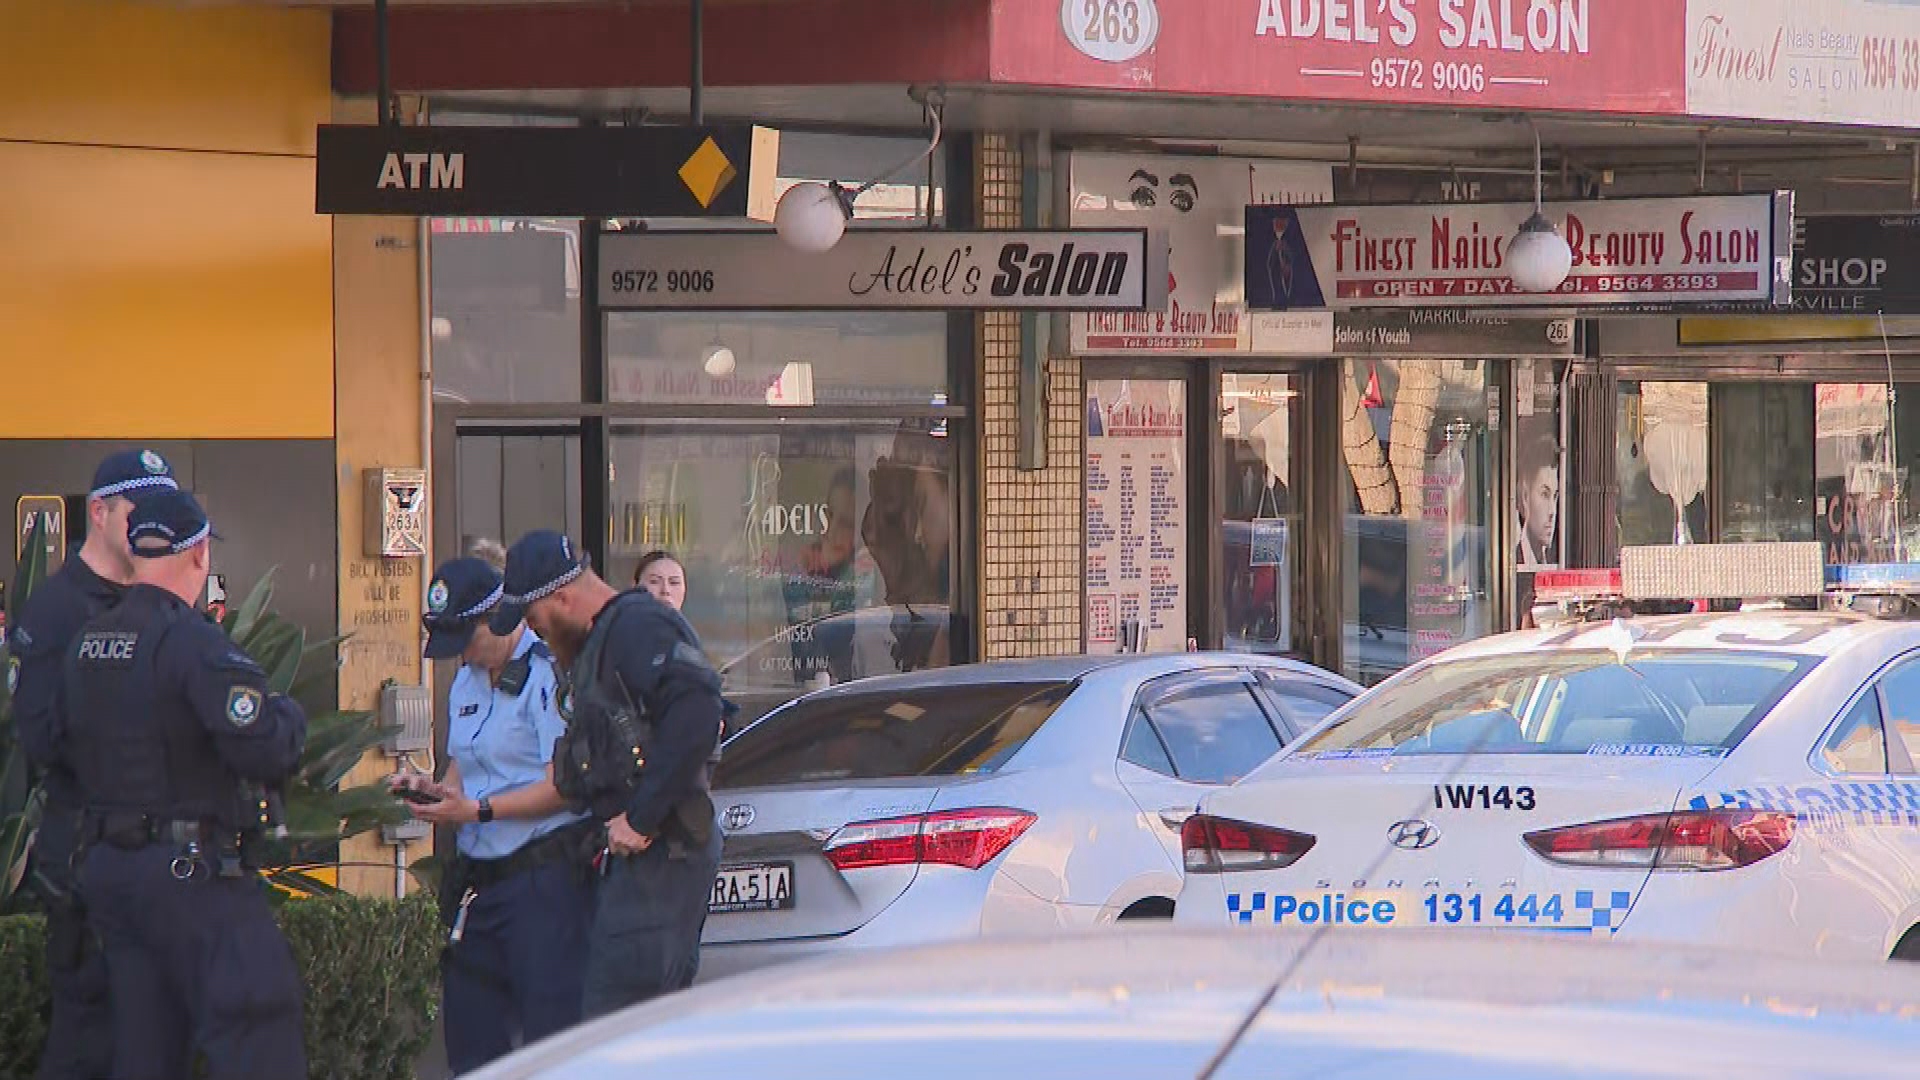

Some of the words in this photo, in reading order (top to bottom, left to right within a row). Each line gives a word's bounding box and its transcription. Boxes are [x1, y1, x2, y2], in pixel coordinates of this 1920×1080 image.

[1083, 0, 1140, 44] 263
[1254, 0, 1419, 46] ADEL'S
[1438, 0, 1590, 53] SALON
[1694, 16, 1783, 82] Finest
[1786, 30, 1814, 49] Nails
[1820, 30, 1860, 54] Beauty
[1370, 57, 1424, 90] 9572
[1432, 62, 1486, 93] 9006
[1862, 35, 1896, 89] 9564
[1788, 66, 1858, 92] SALON
[376, 153, 465, 190] ATM
[1680, 209, 1759, 265] SALON
[612, 270, 658, 293] 9572
[667, 270, 714, 293] 9006
[848, 244, 981, 295] Adel's
[990, 241, 1129, 297] Salon
[1801, 258, 1888, 286] SHOP
[1373, 280, 1434, 296] OPEN
[1444, 279, 1456, 295] 7
[1464, 277, 1523, 294] DAY
[1556, 276, 1590, 292] el.
[1597, 276, 1654, 292] 9564
[1662, 274, 1719, 290] 3393
[1335, 326, 1363, 344] Salon
[1378, 326, 1410, 344] Youth
[1549, 321, 1569, 340] 261
[22, 511, 61, 535] AM
[390, 513, 419, 531] 263A
[761, 503, 830, 535] ADEL'S
[374, 560, 414, 578] POSTERS
[774, 624, 816, 643] UNISEX
[78, 639, 136, 659] POLICE
[1315, 878, 1518, 889] SONATA
[1274, 893, 1396, 923] Police
[1424, 893, 1482, 923] 131
[1494, 893, 1564, 923] 444
